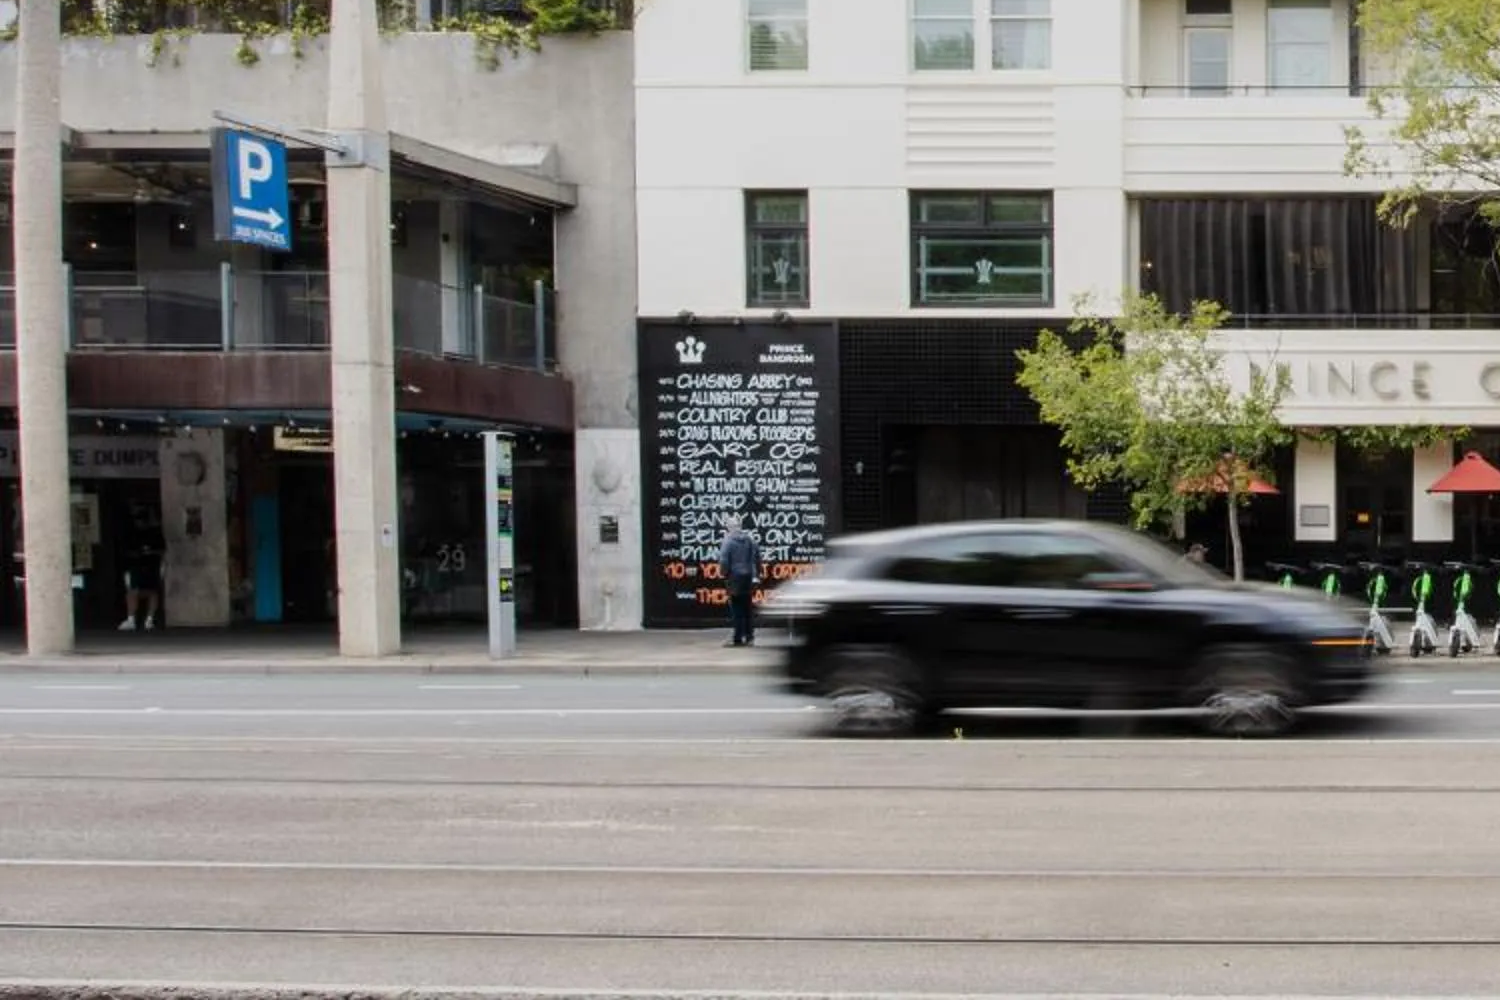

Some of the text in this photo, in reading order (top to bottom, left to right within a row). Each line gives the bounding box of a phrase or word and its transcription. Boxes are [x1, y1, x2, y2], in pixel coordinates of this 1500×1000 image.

[238, 137, 273, 200] P
[769, 344, 804, 353] PRINCE
[759, 354, 814, 363] BANDROOM
[676, 373, 743, 389] CHASING
[747, 373, 796, 389] ABBEY
[1250, 360, 1434, 401] INCE
[677, 408, 750, 424] COUNTRY
[755, 408, 788, 424] CLUB
[94, 449, 160, 467] DUMPL
[676, 441, 761, 459] GARY
[769, 442, 807, 459] OG
[679, 459, 728, 475] REAL
[735, 459, 795, 475] ESTATE
[754, 477, 789, 493] SHOW
[679, 493, 747, 510] CUSTARD
[680, 528, 761, 545] BELS
[765, 528, 809, 545] ONLY
[436, 550, 466, 572] 29
